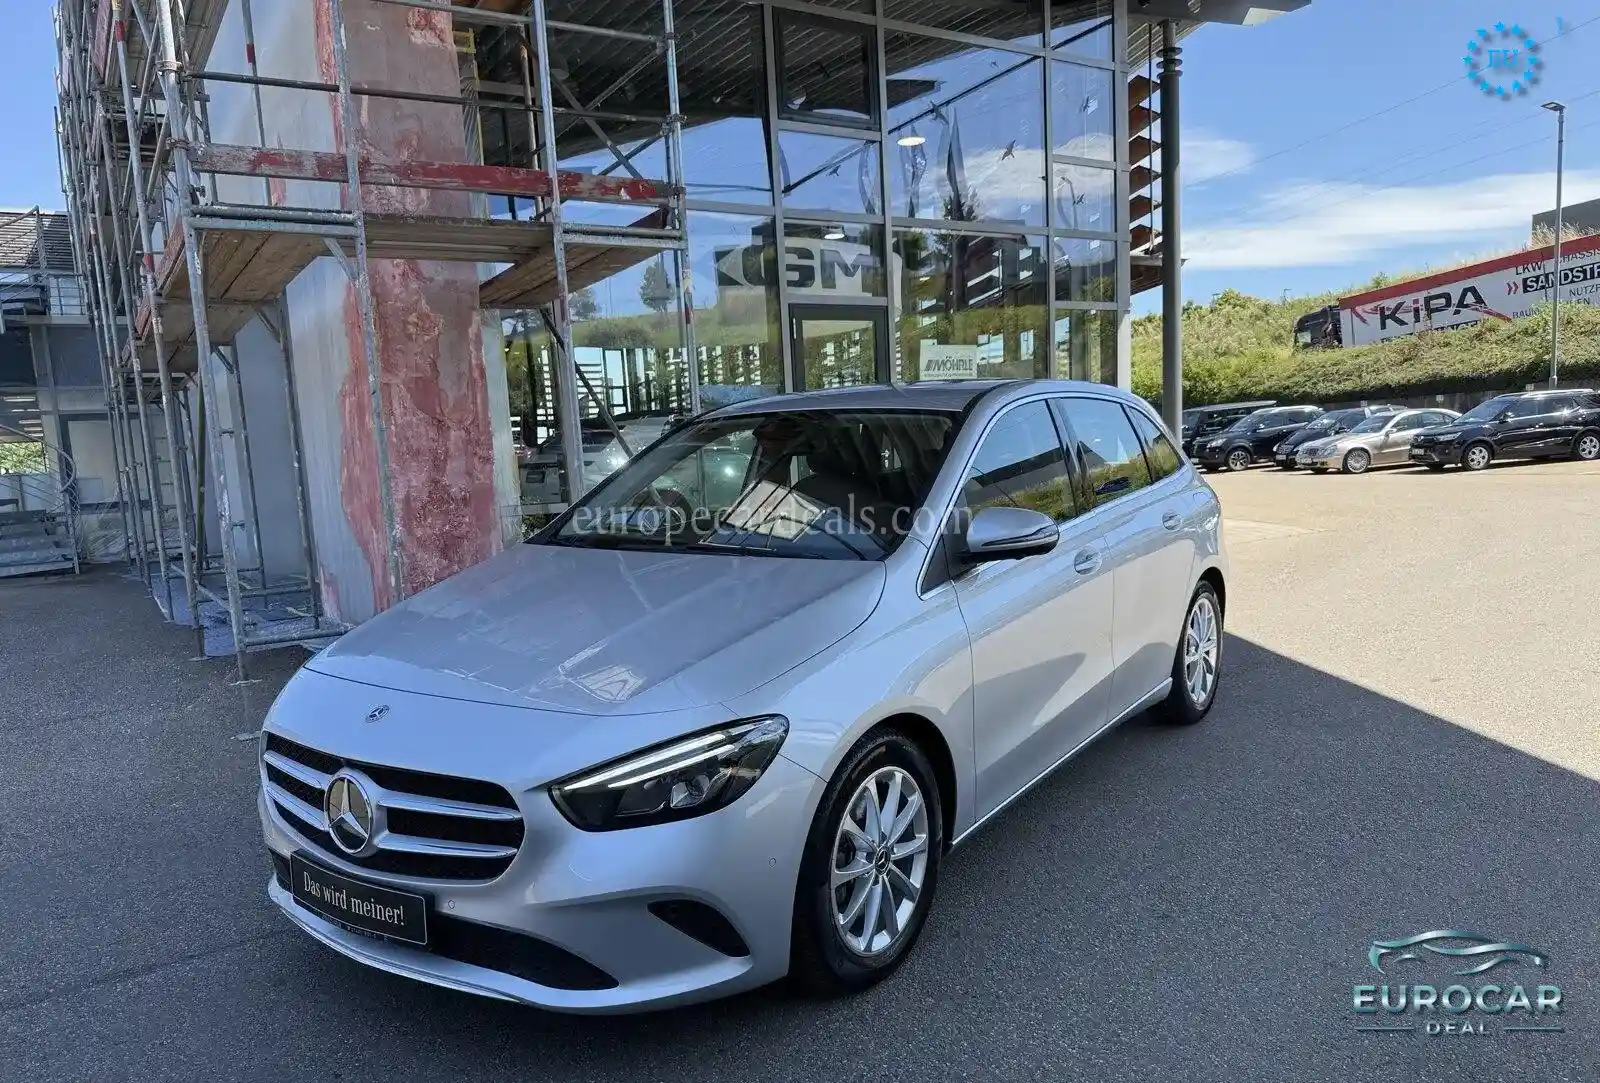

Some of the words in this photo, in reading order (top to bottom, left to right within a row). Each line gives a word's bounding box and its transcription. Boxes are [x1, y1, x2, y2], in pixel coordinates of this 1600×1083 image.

[1515, 260, 1544, 276] LKW
[303, 871, 321, 898] Das
[323, 886, 347, 909] wird
[350, 898, 405, 926] meiner!
